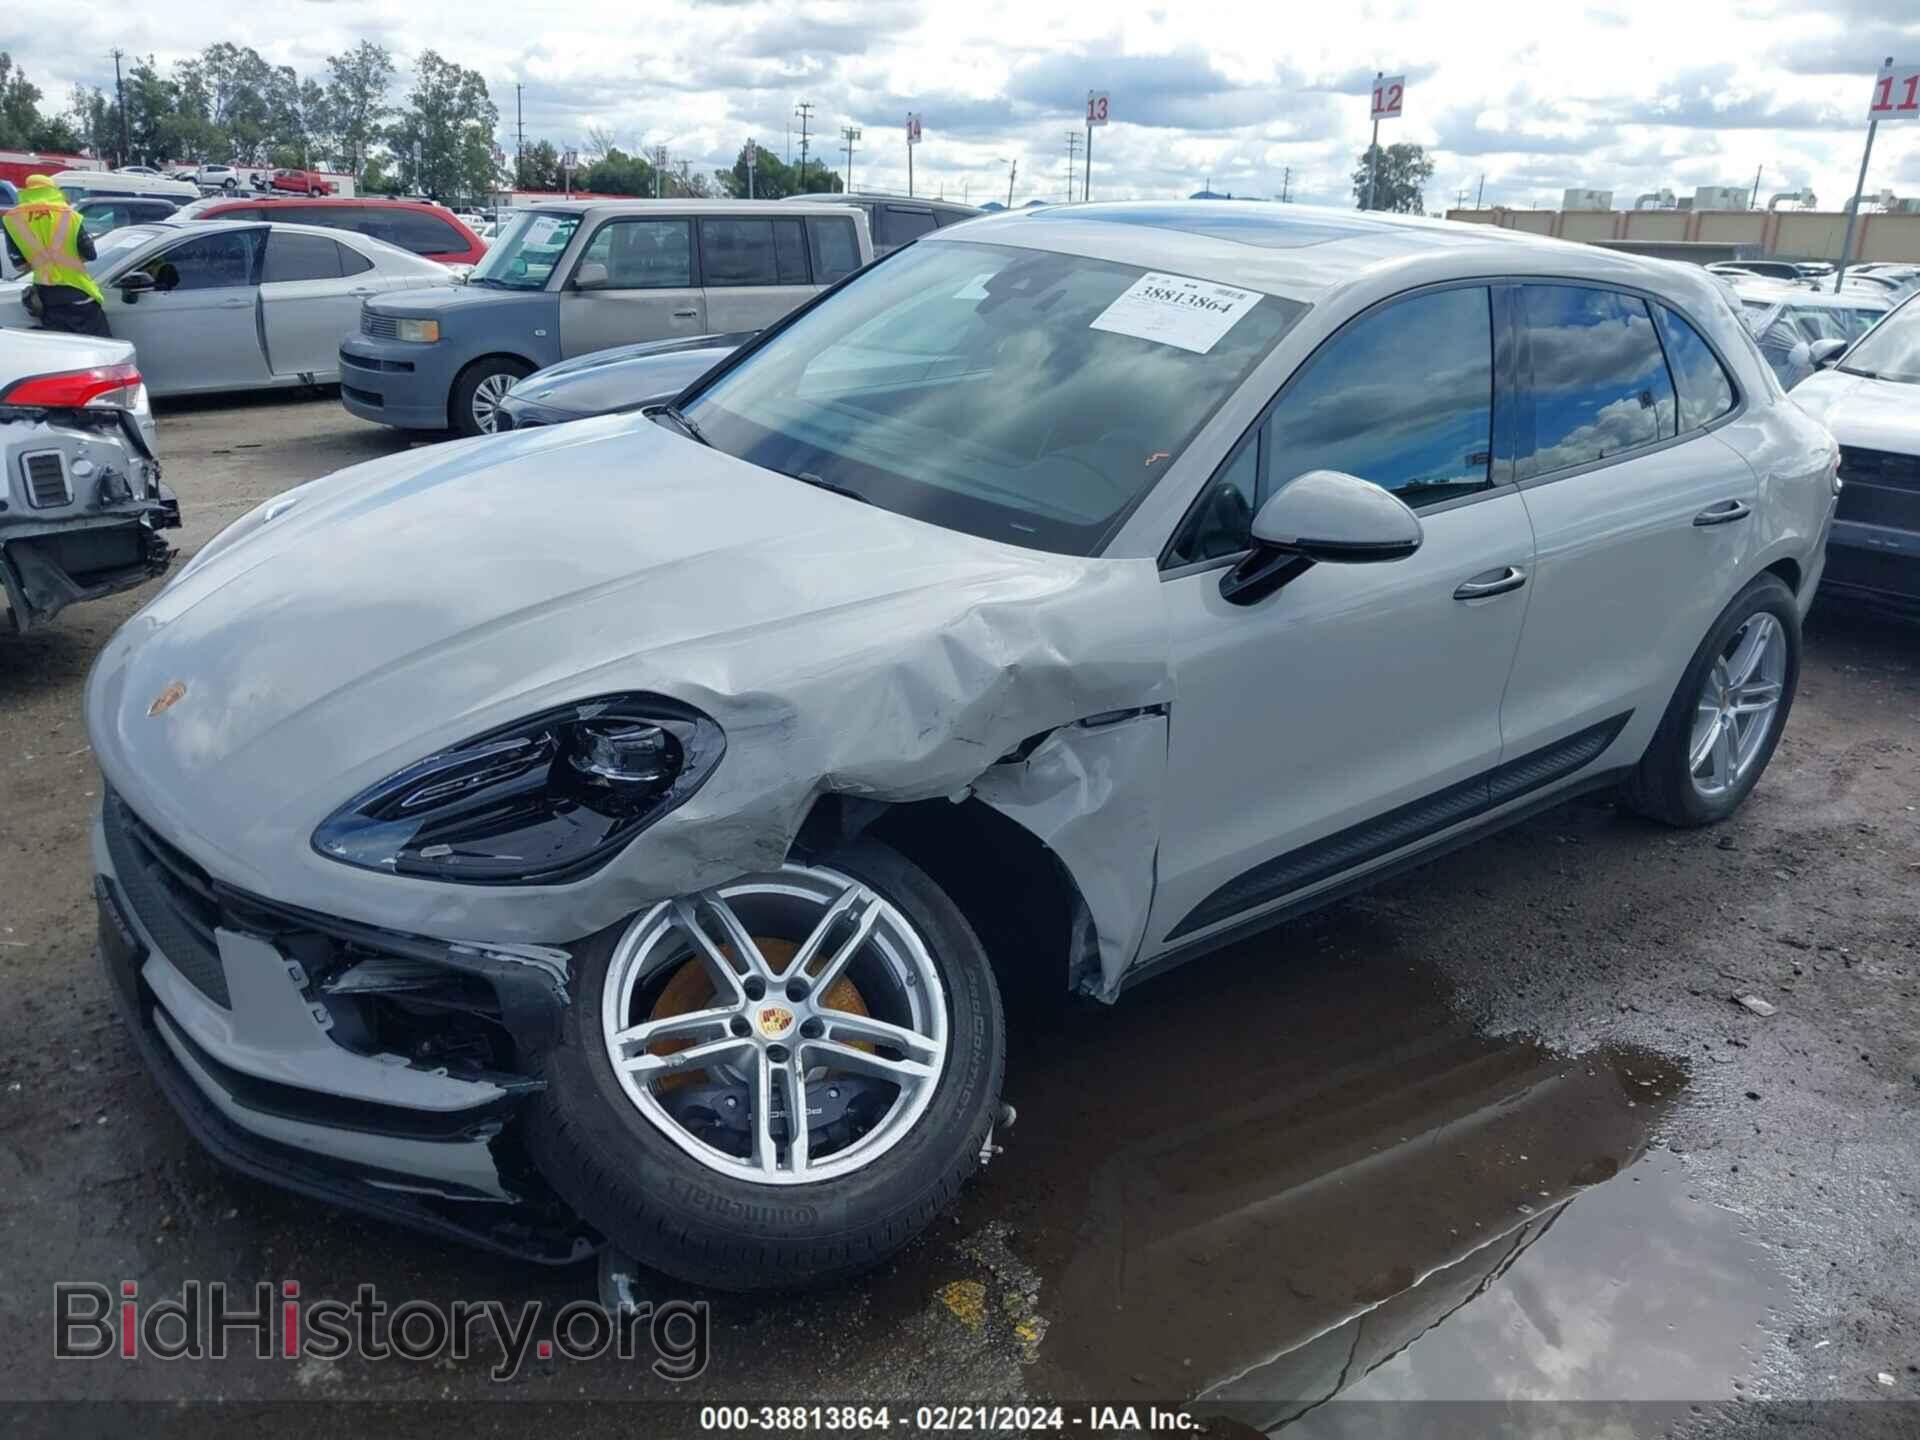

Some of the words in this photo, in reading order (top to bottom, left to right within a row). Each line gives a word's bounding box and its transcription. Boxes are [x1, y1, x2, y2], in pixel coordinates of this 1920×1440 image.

[1373, 84, 1403, 112] 12
[1872, 75, 1919, 111] 11
[1088, 97, 1108, 120] 13
[906, 119, 921, 140] 14
[565, 151, 578, 166] 17
[1137, 286, 1233, 313] 38813864
[684, 1182, 819, 1226] Continental
